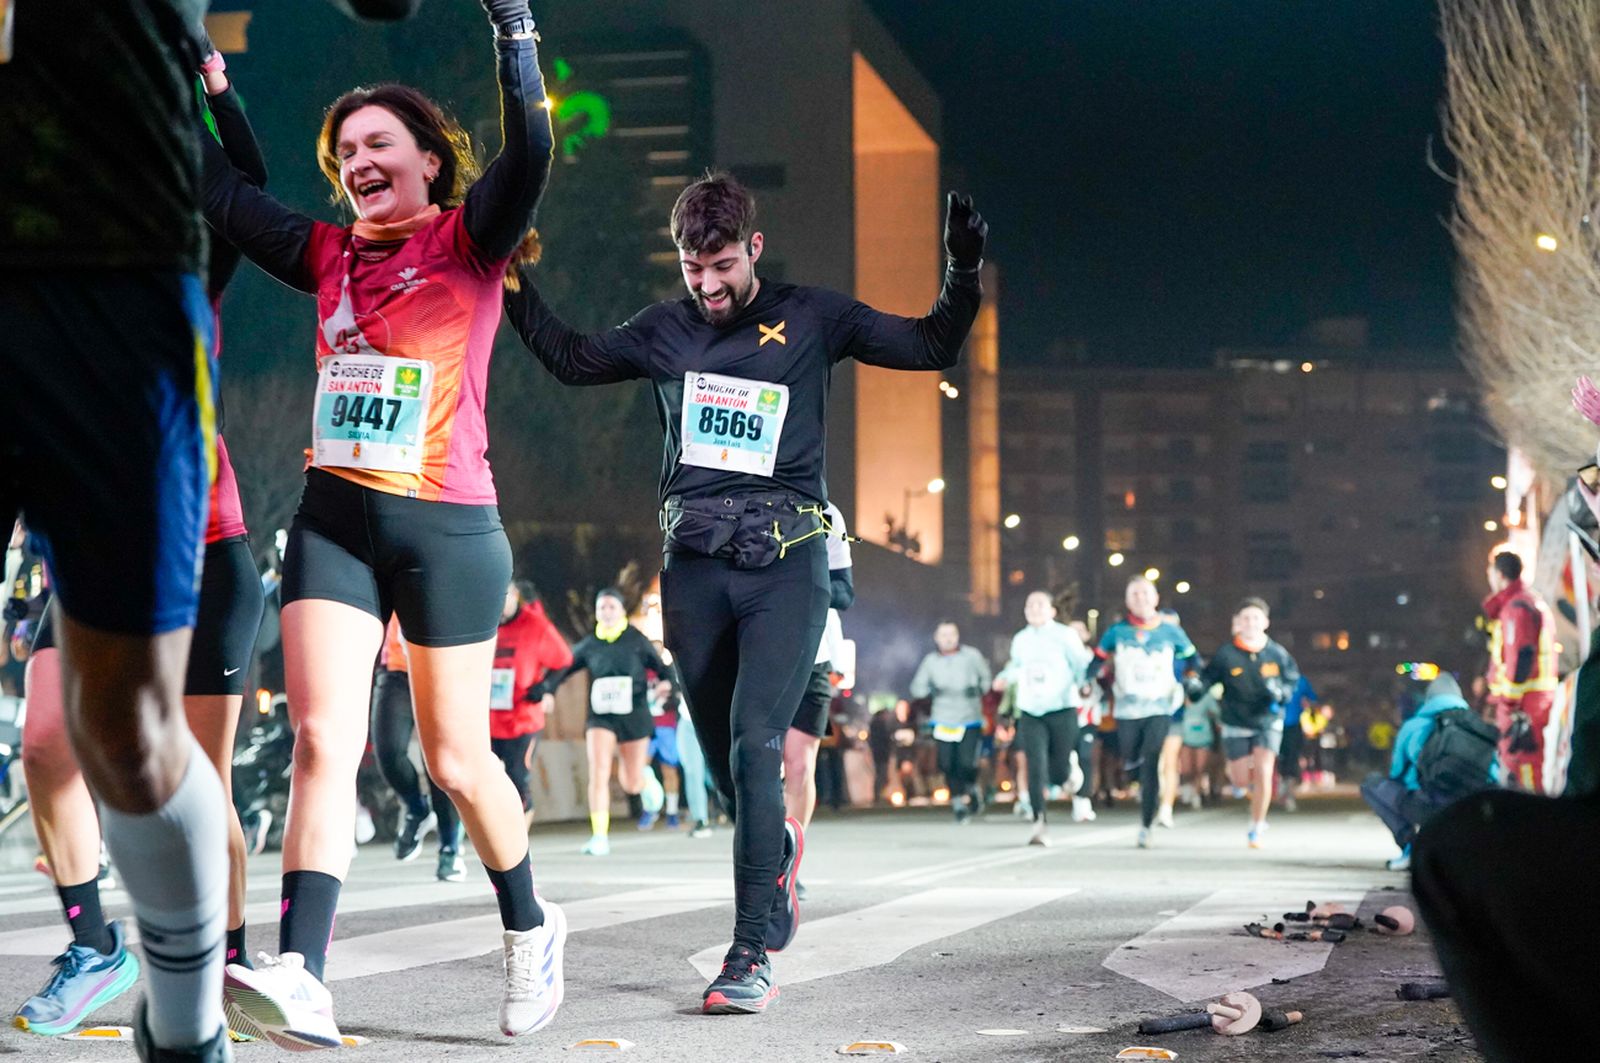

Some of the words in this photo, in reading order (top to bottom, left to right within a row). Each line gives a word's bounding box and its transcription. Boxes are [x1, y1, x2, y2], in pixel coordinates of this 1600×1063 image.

[341, 367, 370, 379] NOCHE
[371, 368, 385, 380] DE
[328, 381, 345, 392] SAN
[707, 383, 736, 395] NOCHE
[738, 388, 750, 397] DE
[695, 393, 714, 404] SAN
[331, 394, 403, 432] 9447
[698, 406, 764, 441] 8569
[347, 430, 371, 440] SILVIA
[713, 437, 726, 446] Juan
